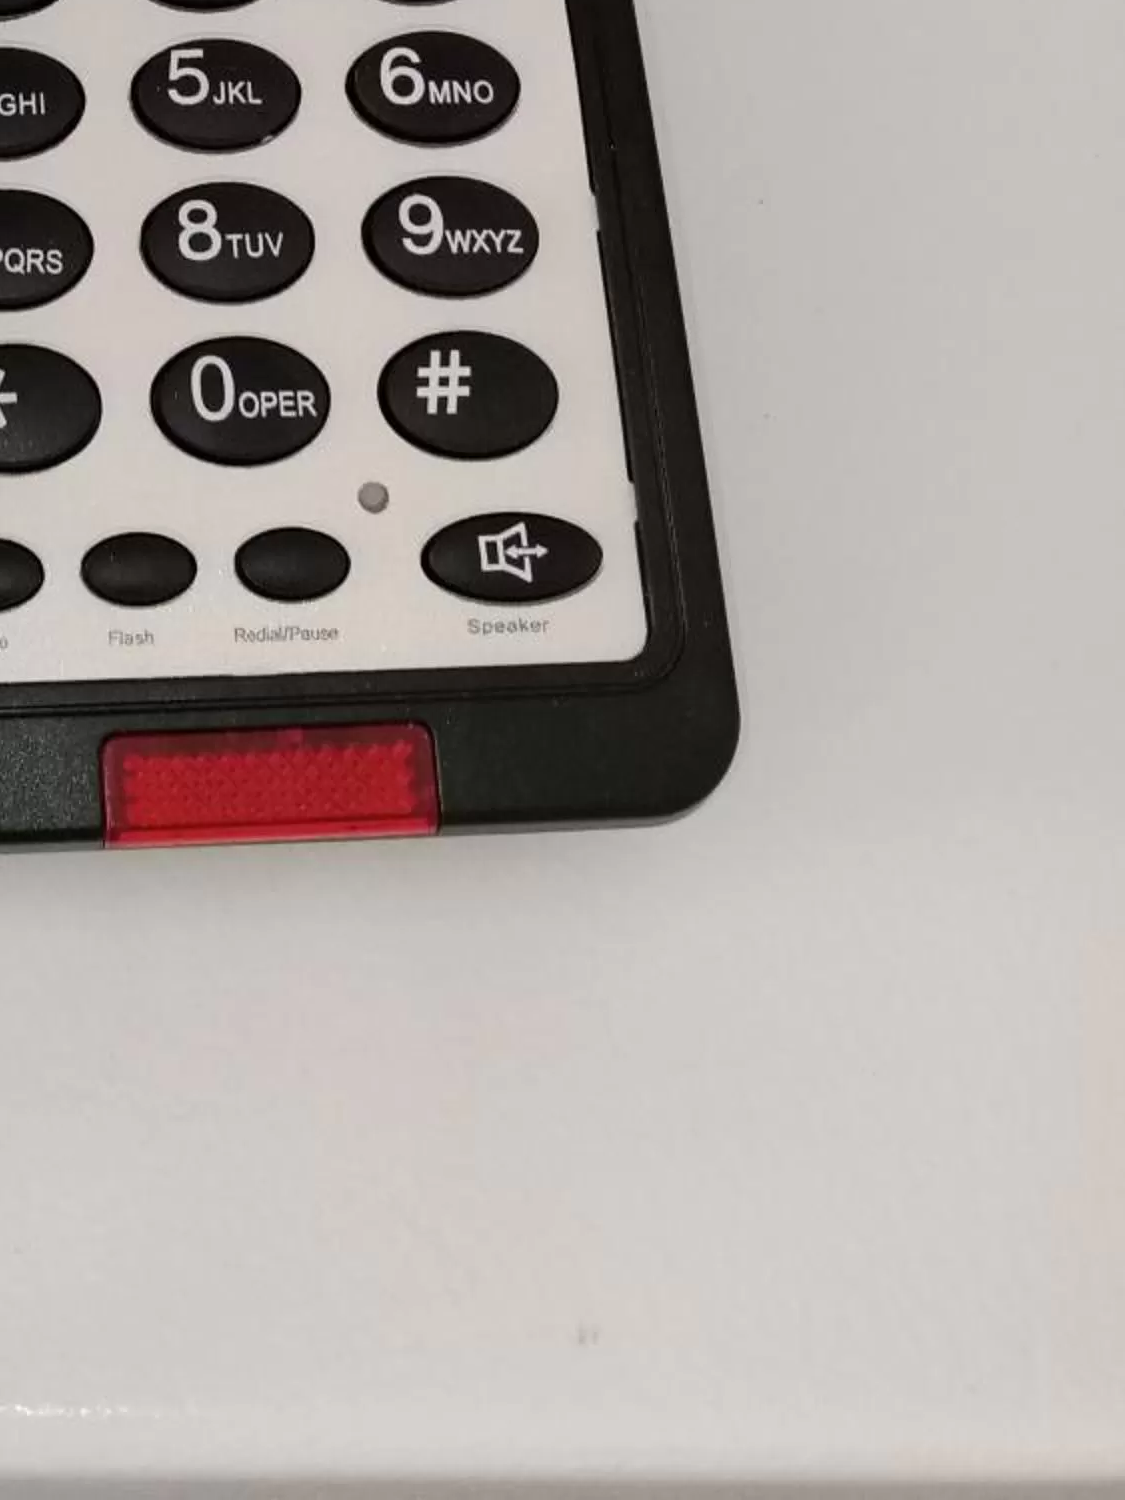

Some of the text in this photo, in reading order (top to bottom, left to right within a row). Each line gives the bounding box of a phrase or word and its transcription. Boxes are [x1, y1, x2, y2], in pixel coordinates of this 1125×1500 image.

[167, 48, 263, 106] 5 JKL
[379, 46, 494, 106] 6 MNO
[178, 199, 284, 262] 8 TUV
[398, 193, 524, 256] 9 WXYZ
[190, 354, 318, 422] 0 OPER
[416, 349, 472, 415] #
[107, 628, 156, 647] Flash
[233, 624, 340, 645] Redial/Pause
[466, 616, 550, 640] Speaker
